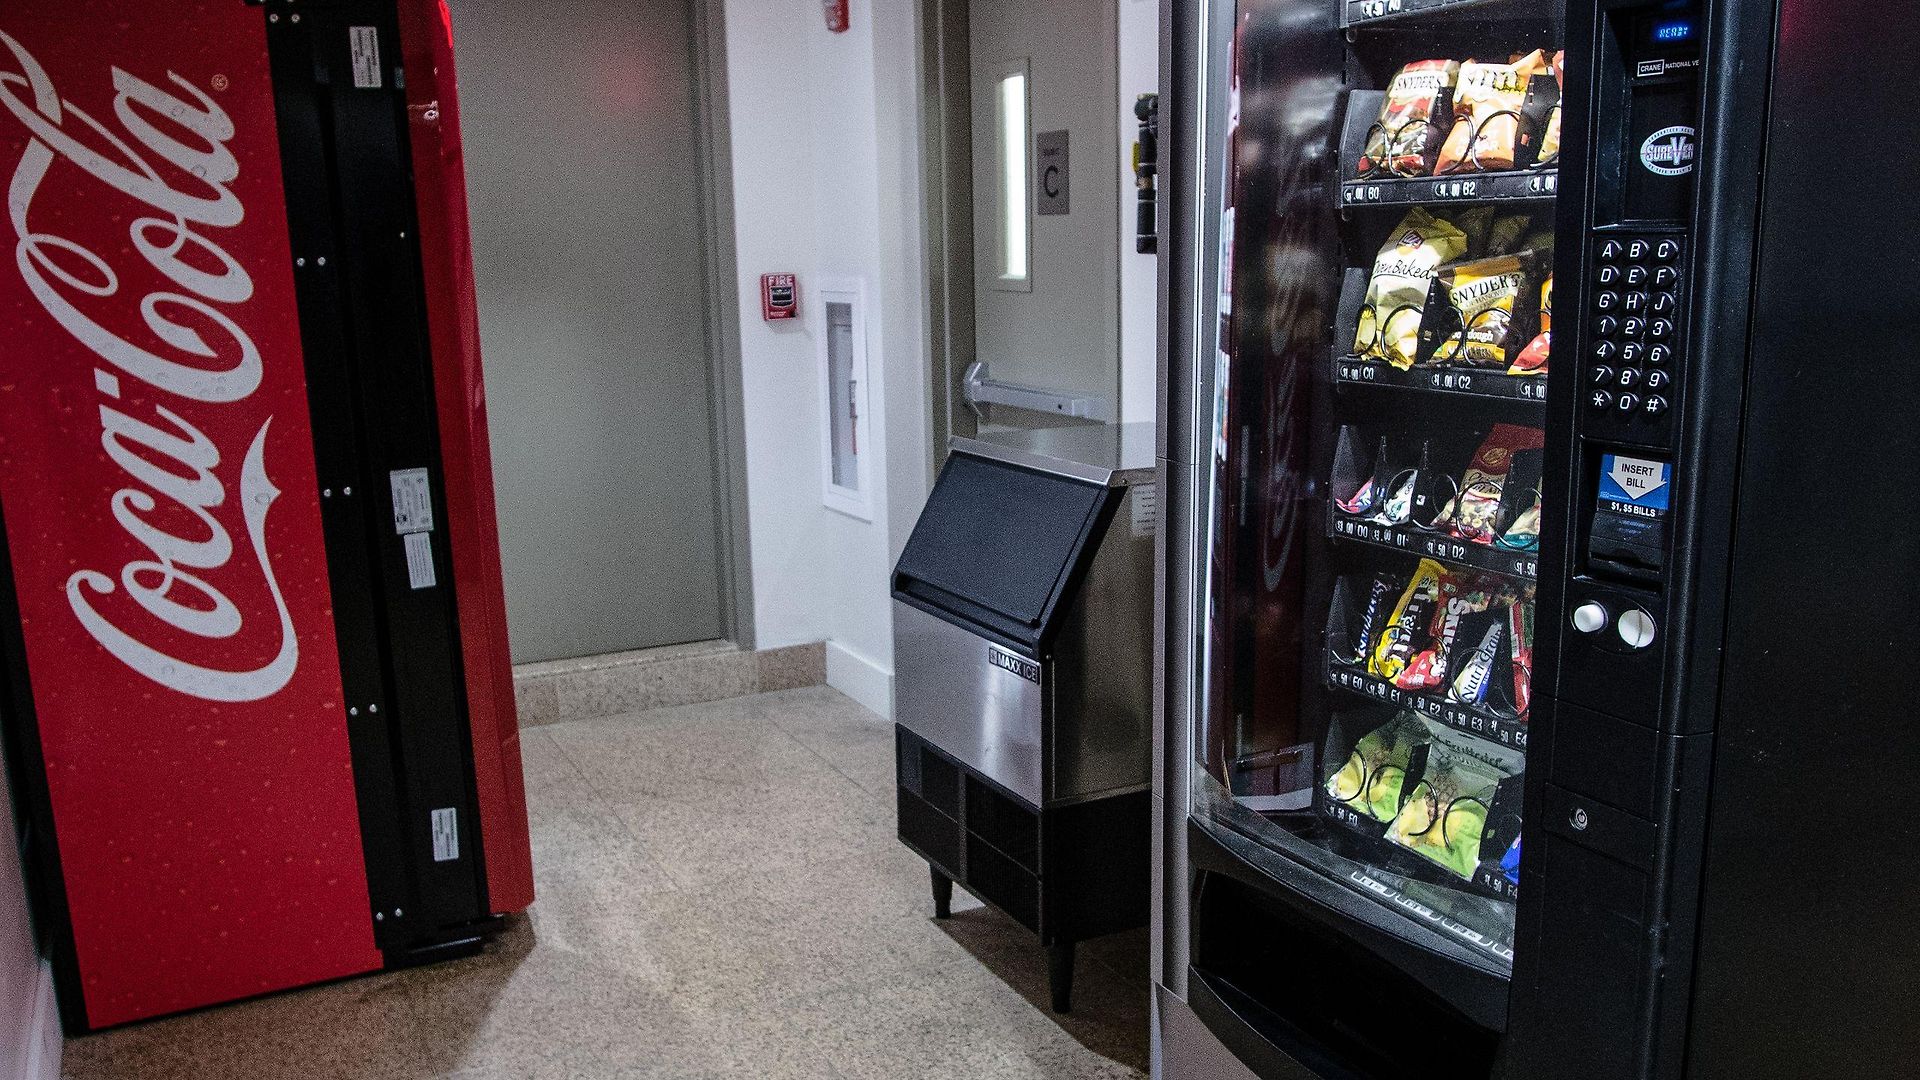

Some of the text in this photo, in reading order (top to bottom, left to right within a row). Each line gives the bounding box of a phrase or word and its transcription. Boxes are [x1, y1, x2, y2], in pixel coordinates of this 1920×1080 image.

[1659, 26, 1688, 38] READY
[1640, 63, 1661, 73] CRANE
[1665, 60, 1691, 69] NATIONAL
[1044, 165, 1059, 198] C
[1602, 243, 1670, 258] A B C
[768, 275, 793, 287] FIRE
[1601, 269, 1666, 284] D E F
[1451, 273, 1520, 305] SNYDER'S
[1599, 294, 1665, 311] G H J
[1600, 320, 1663, 336] 1 2 3
[1597, 344, 1661, 362] 4 5 6
[0, 28, 299, 703] Coca-Cola
[1458, 375, 1471, 390] C2
[1595, 368, 1660, 387] 7 8 9
[1619, 395, 1659, 412] 0 #
[1621, 463, 1654, 476] INSERT
[1626, 477, 1646, 489] BILL
[1611, 501, 1656, 517] $1, $5 BILLS
[997, 652, 1037, 681] MAXX ICE
[1462, 663, 1485, 701] Nutri
[1390, 689, 1401, 703] E1
[1429, 702, 1441, 717] E2
[1471, 716, 1483, 731] E3
